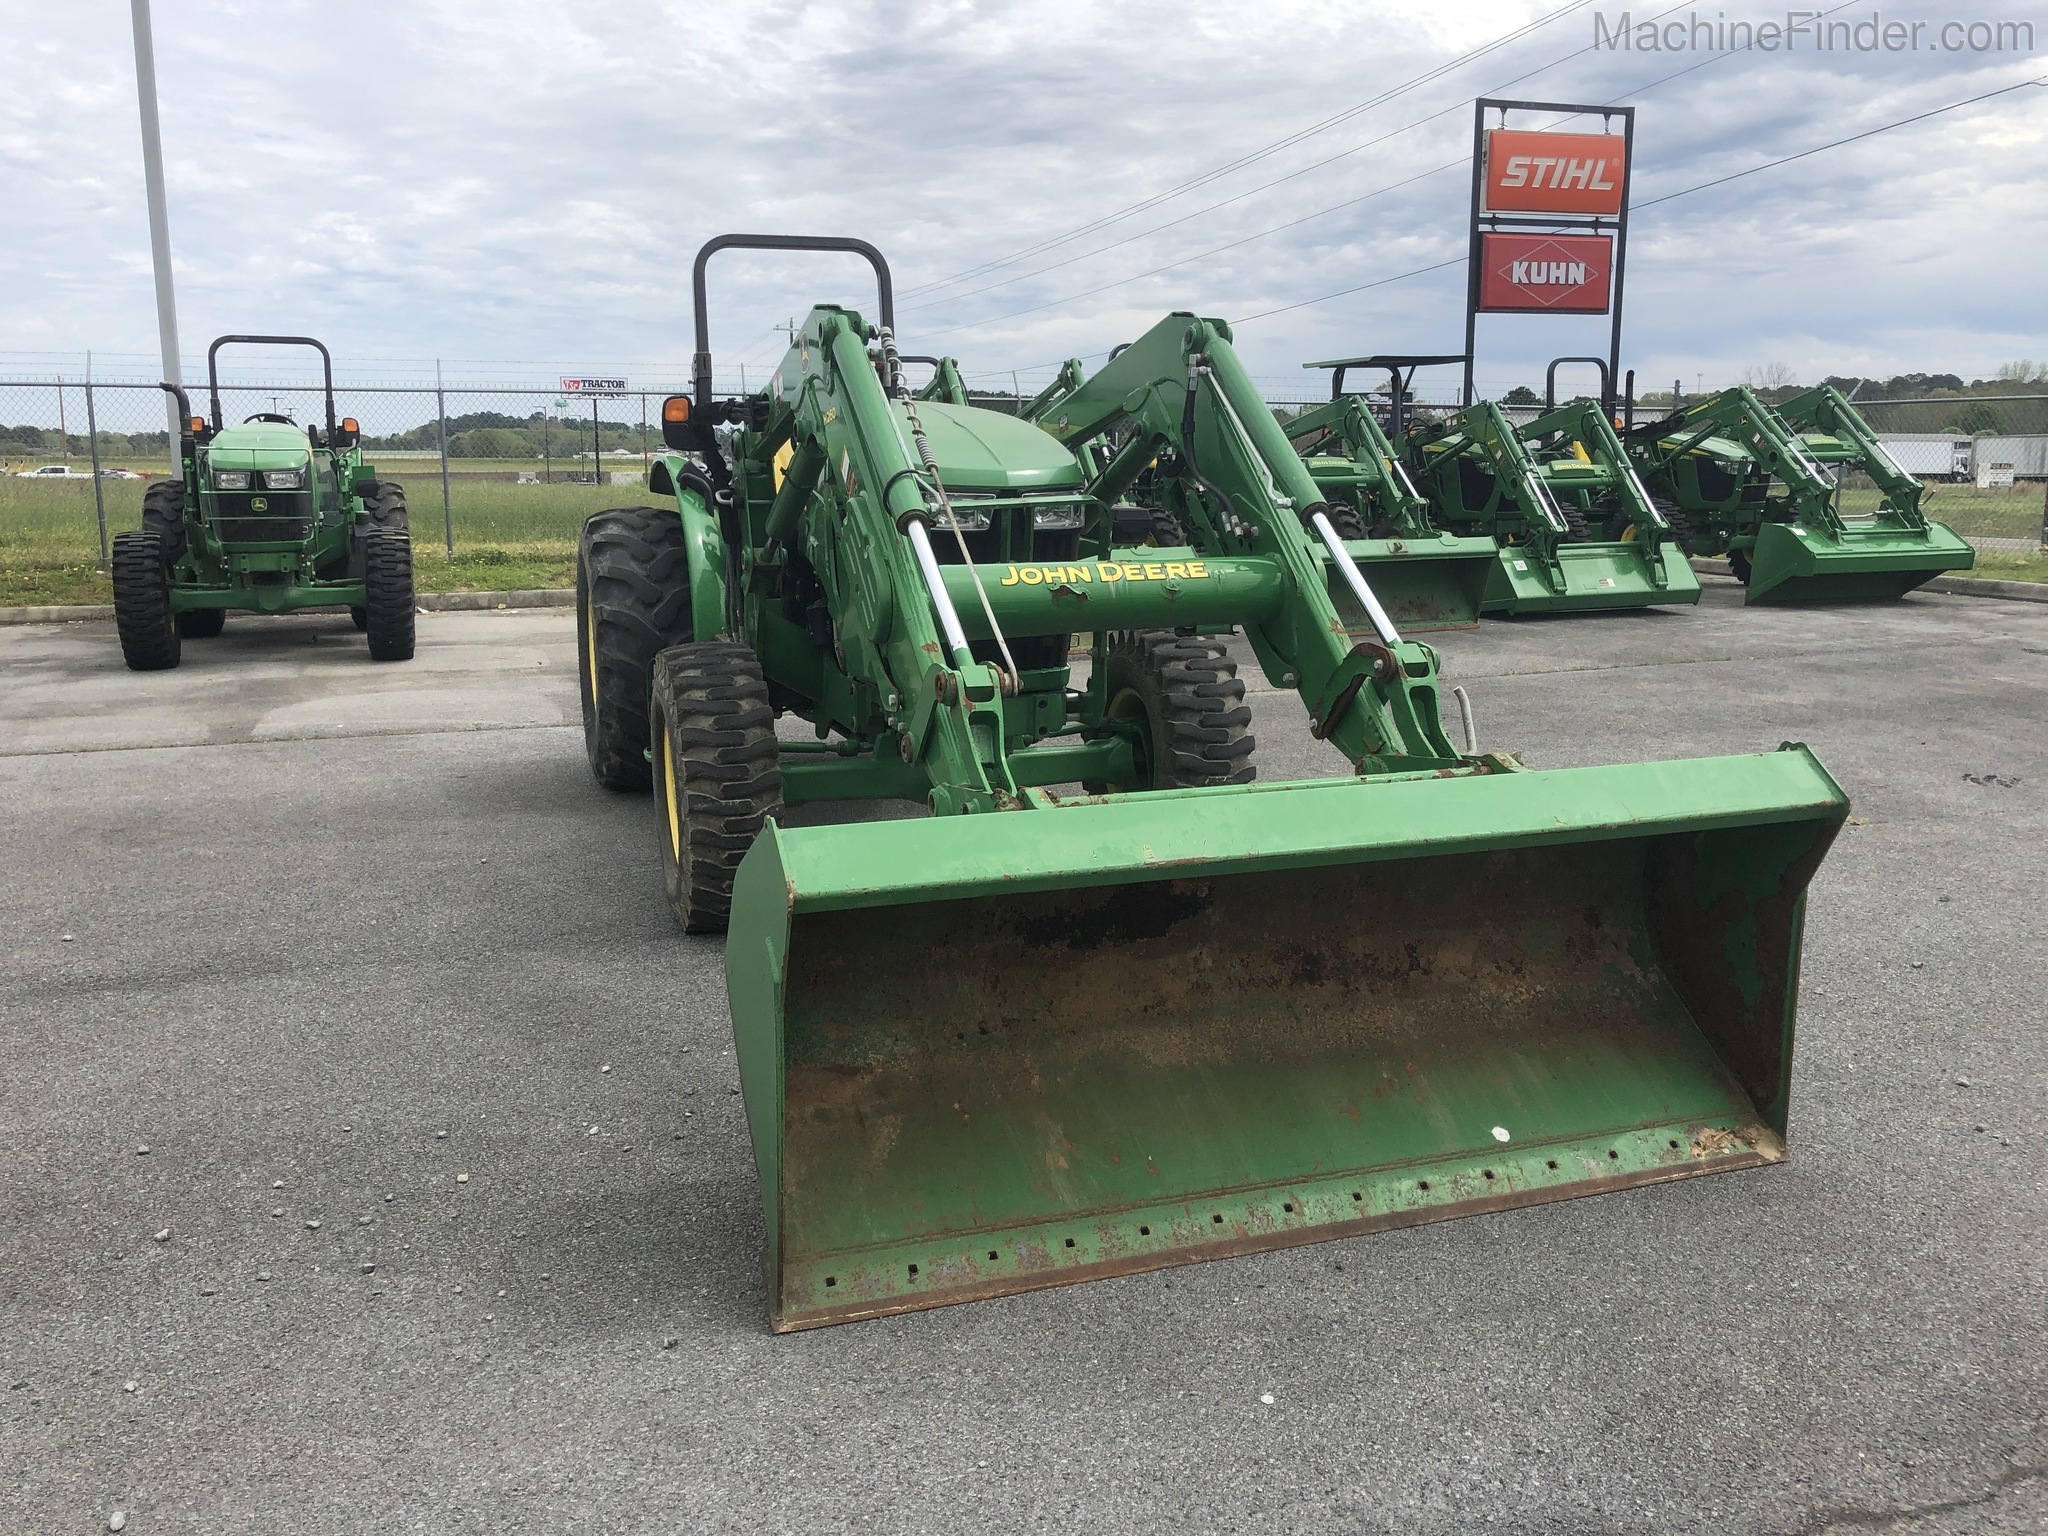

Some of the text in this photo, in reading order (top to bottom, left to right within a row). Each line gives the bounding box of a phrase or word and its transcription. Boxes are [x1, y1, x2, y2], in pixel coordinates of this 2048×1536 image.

[1500, 156, 1614, 190] STIHL
[1512, 261, 1586, 285] KUHN
[581, 380, 626, 389] TRACTOR
[823, 407, 836, 426] H260
[1001, 561, 1210, 586] JOHN DEERE
